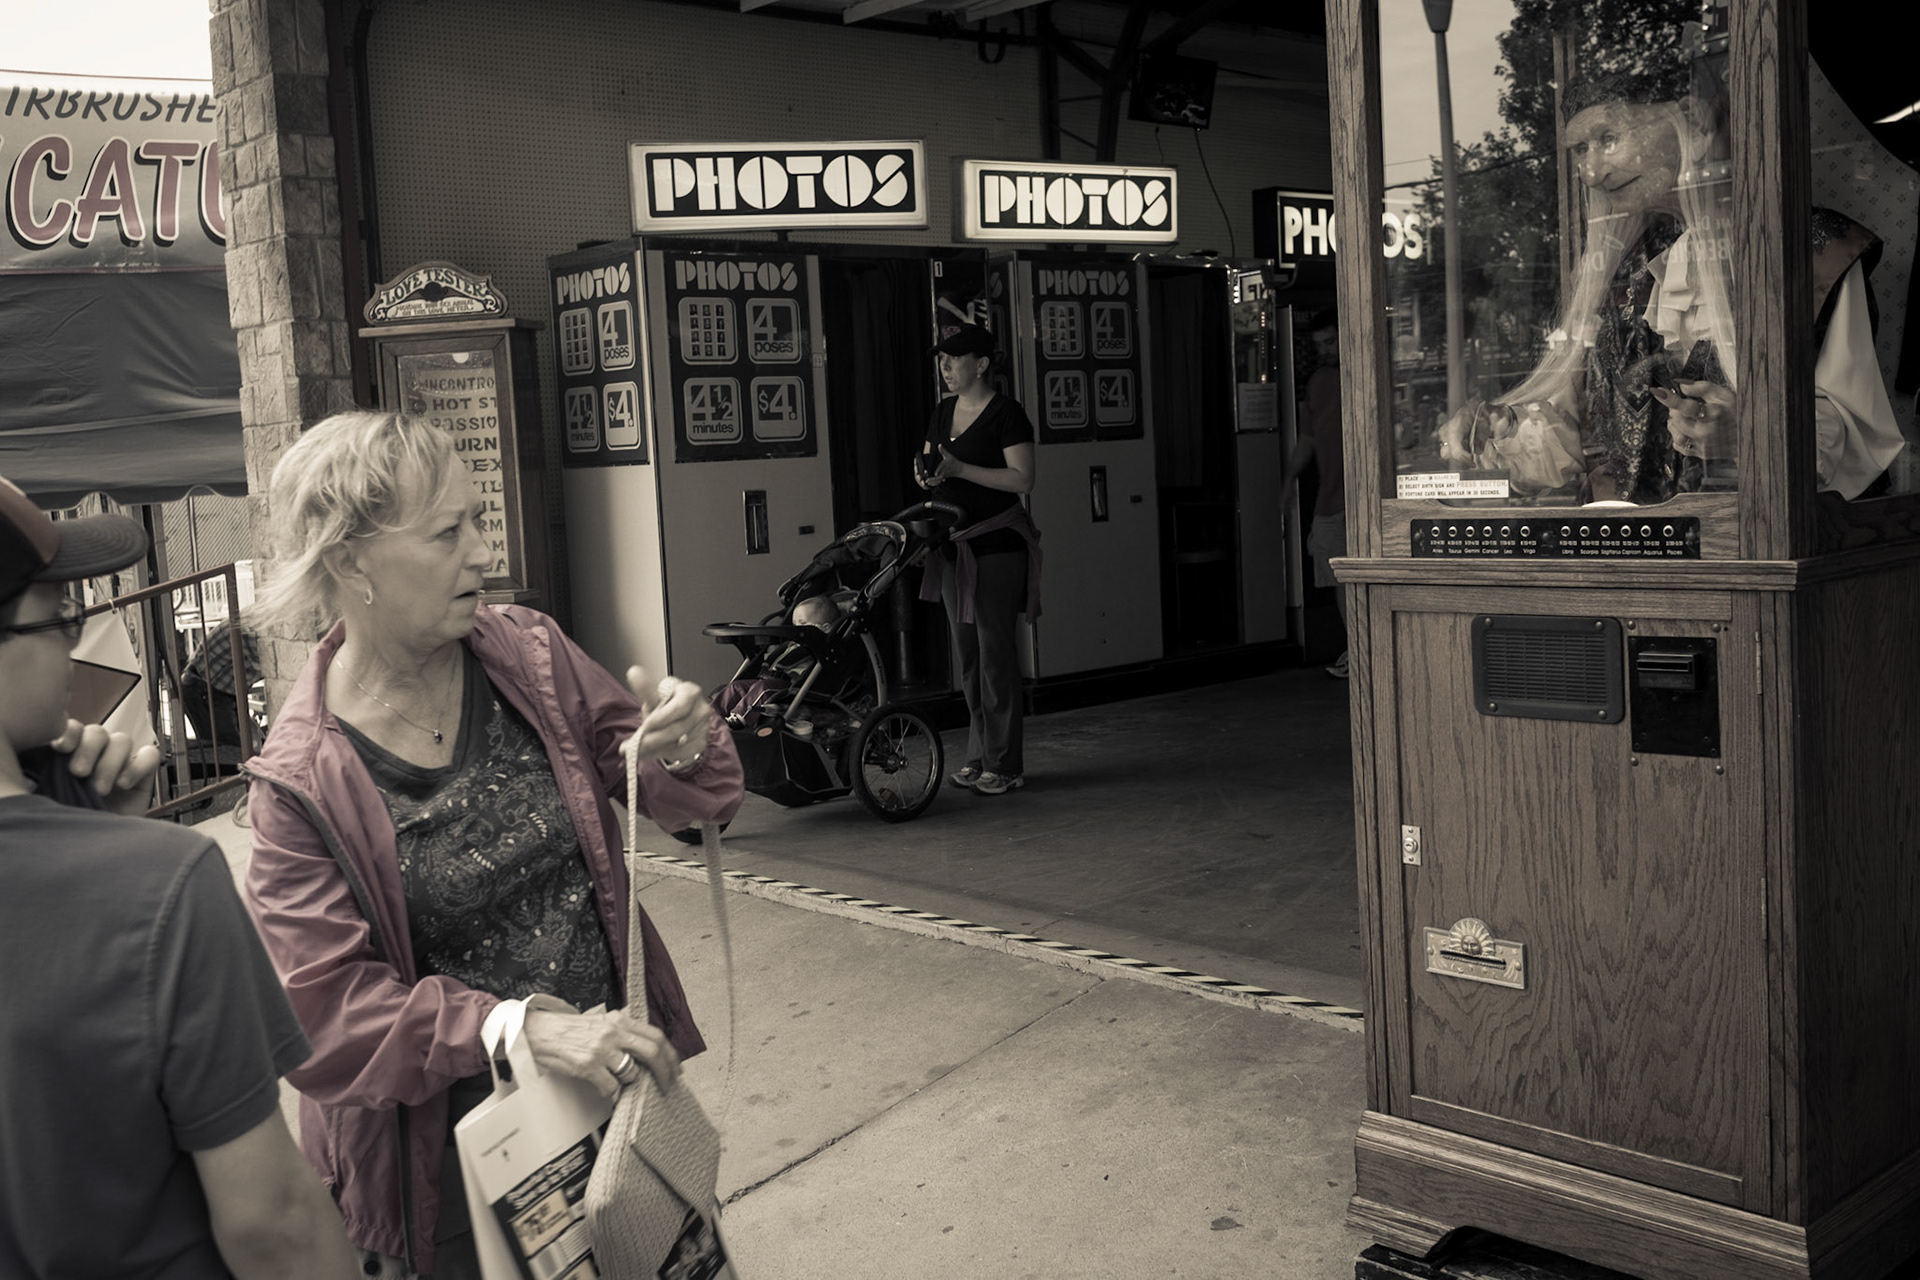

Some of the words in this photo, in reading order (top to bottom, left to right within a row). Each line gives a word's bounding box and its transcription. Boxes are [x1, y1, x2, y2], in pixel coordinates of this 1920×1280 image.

[652, 153, 909, 212] PHOTOS
[984, 174, 1169, 227] PHOTOS
[383, 272, 422, 306] LOVE
[423, 267, 488, 297] TESTER
[557, 262, 631, 305] PHOTOS
[675, 260, 798, 291] PHOTOS
[1038, 269, 1130, 296] PHOTOS
[602, 309, 618, 348] 4
[753, 304, 777, 342] 4
[1096, 307, 1114, 339] 4
[604, 344, 630, 363] poses
[754, 340, 794, 355] poses
[1096, 338, 1127, 351] poses
[433, 397, 472, 411] HOT
[1051, 409, 1082, 419] minutes
[571, 431, 595, 442] minutes
[692, 421, 734, 434] minutes
[454, 437, 497, 452] URN
[461, 458, 502, 473] EX
